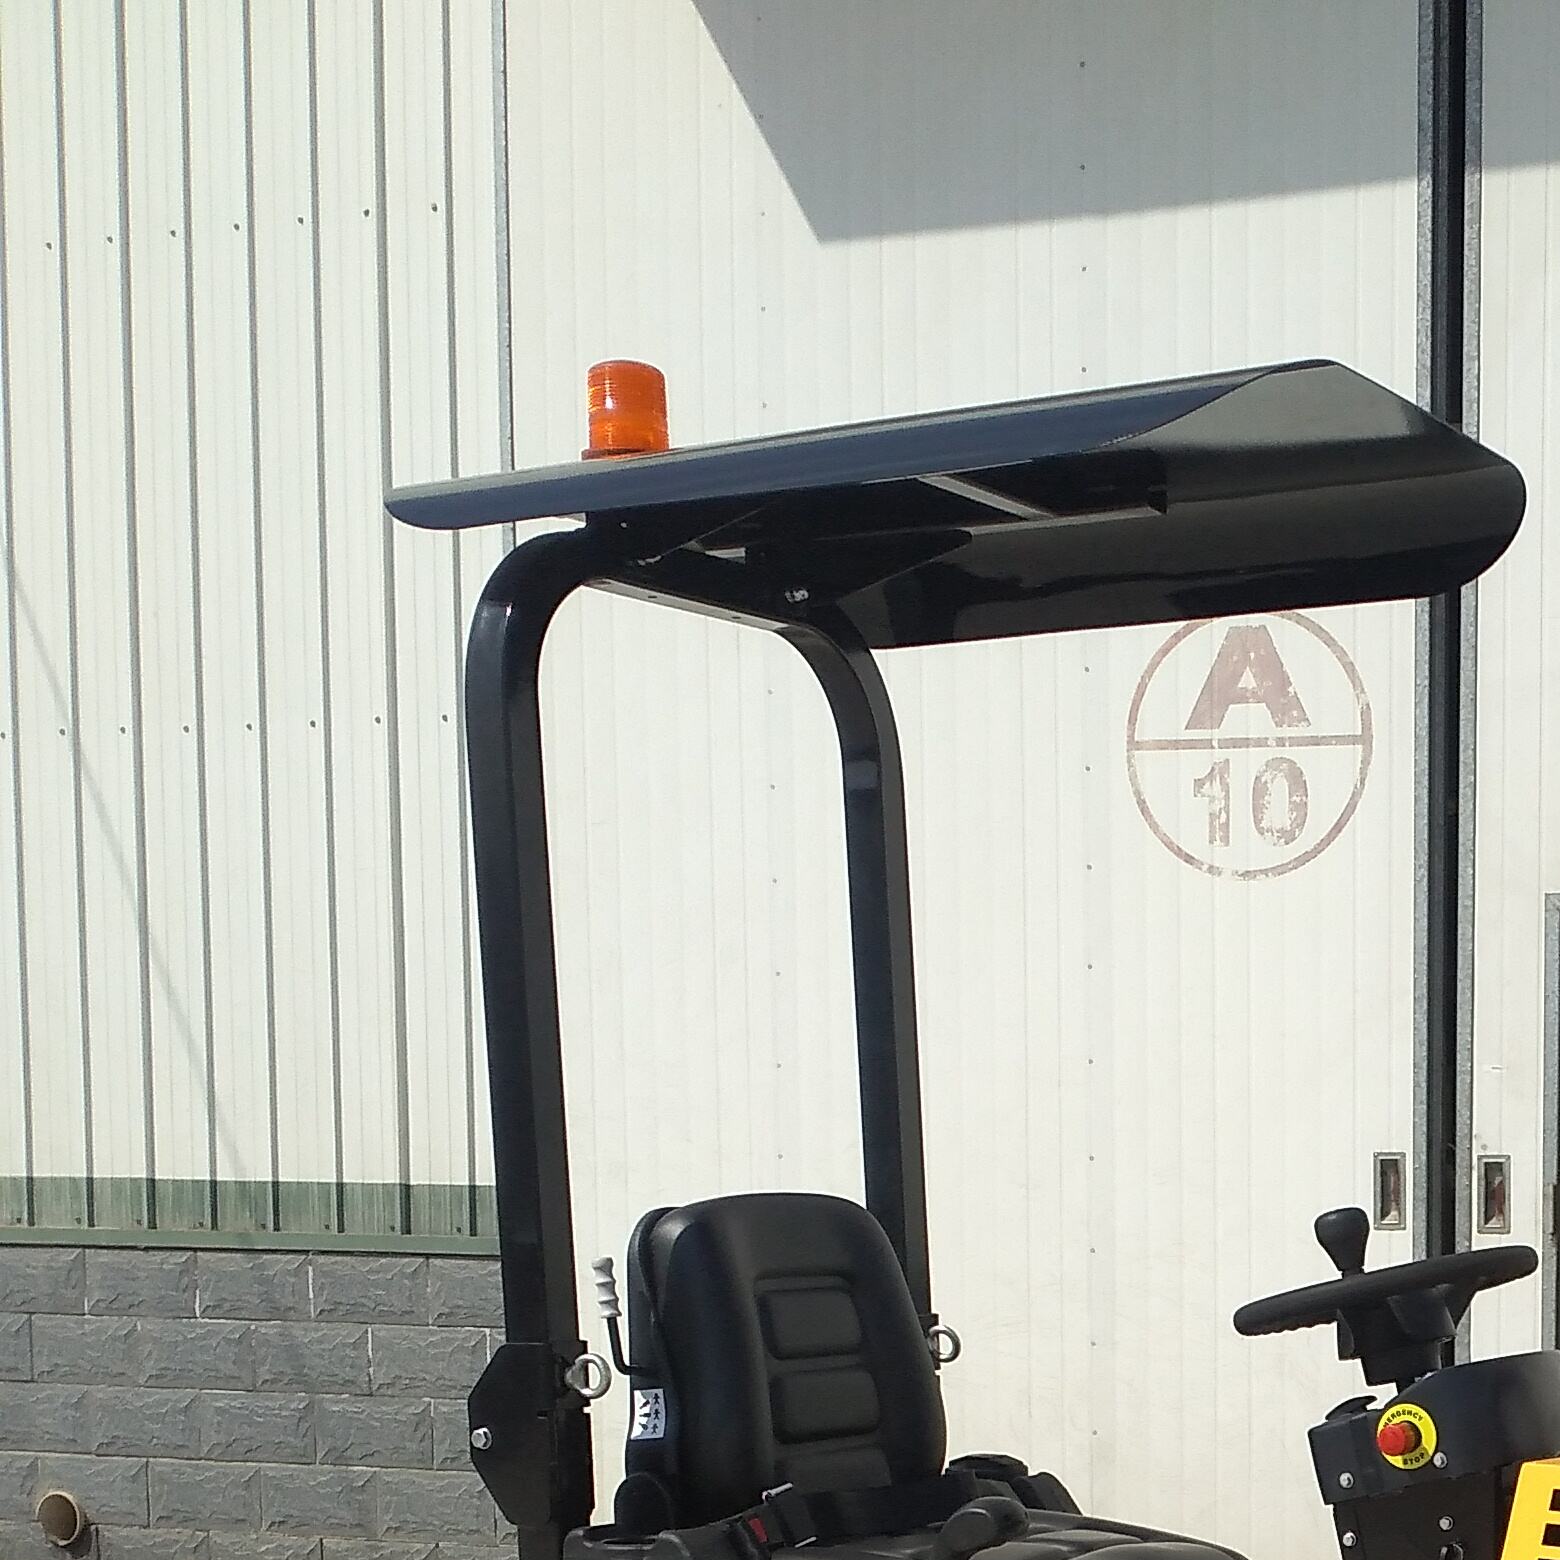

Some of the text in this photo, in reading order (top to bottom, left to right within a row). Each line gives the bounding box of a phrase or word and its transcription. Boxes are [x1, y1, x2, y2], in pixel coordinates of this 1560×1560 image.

[1184, 624, 1311, 730] A
[1193, 756, 1309, 847] 10
[1383, 1409, 1423, 1427] ERGENCY
[1403, 1452, 1425, 1465] STOP
